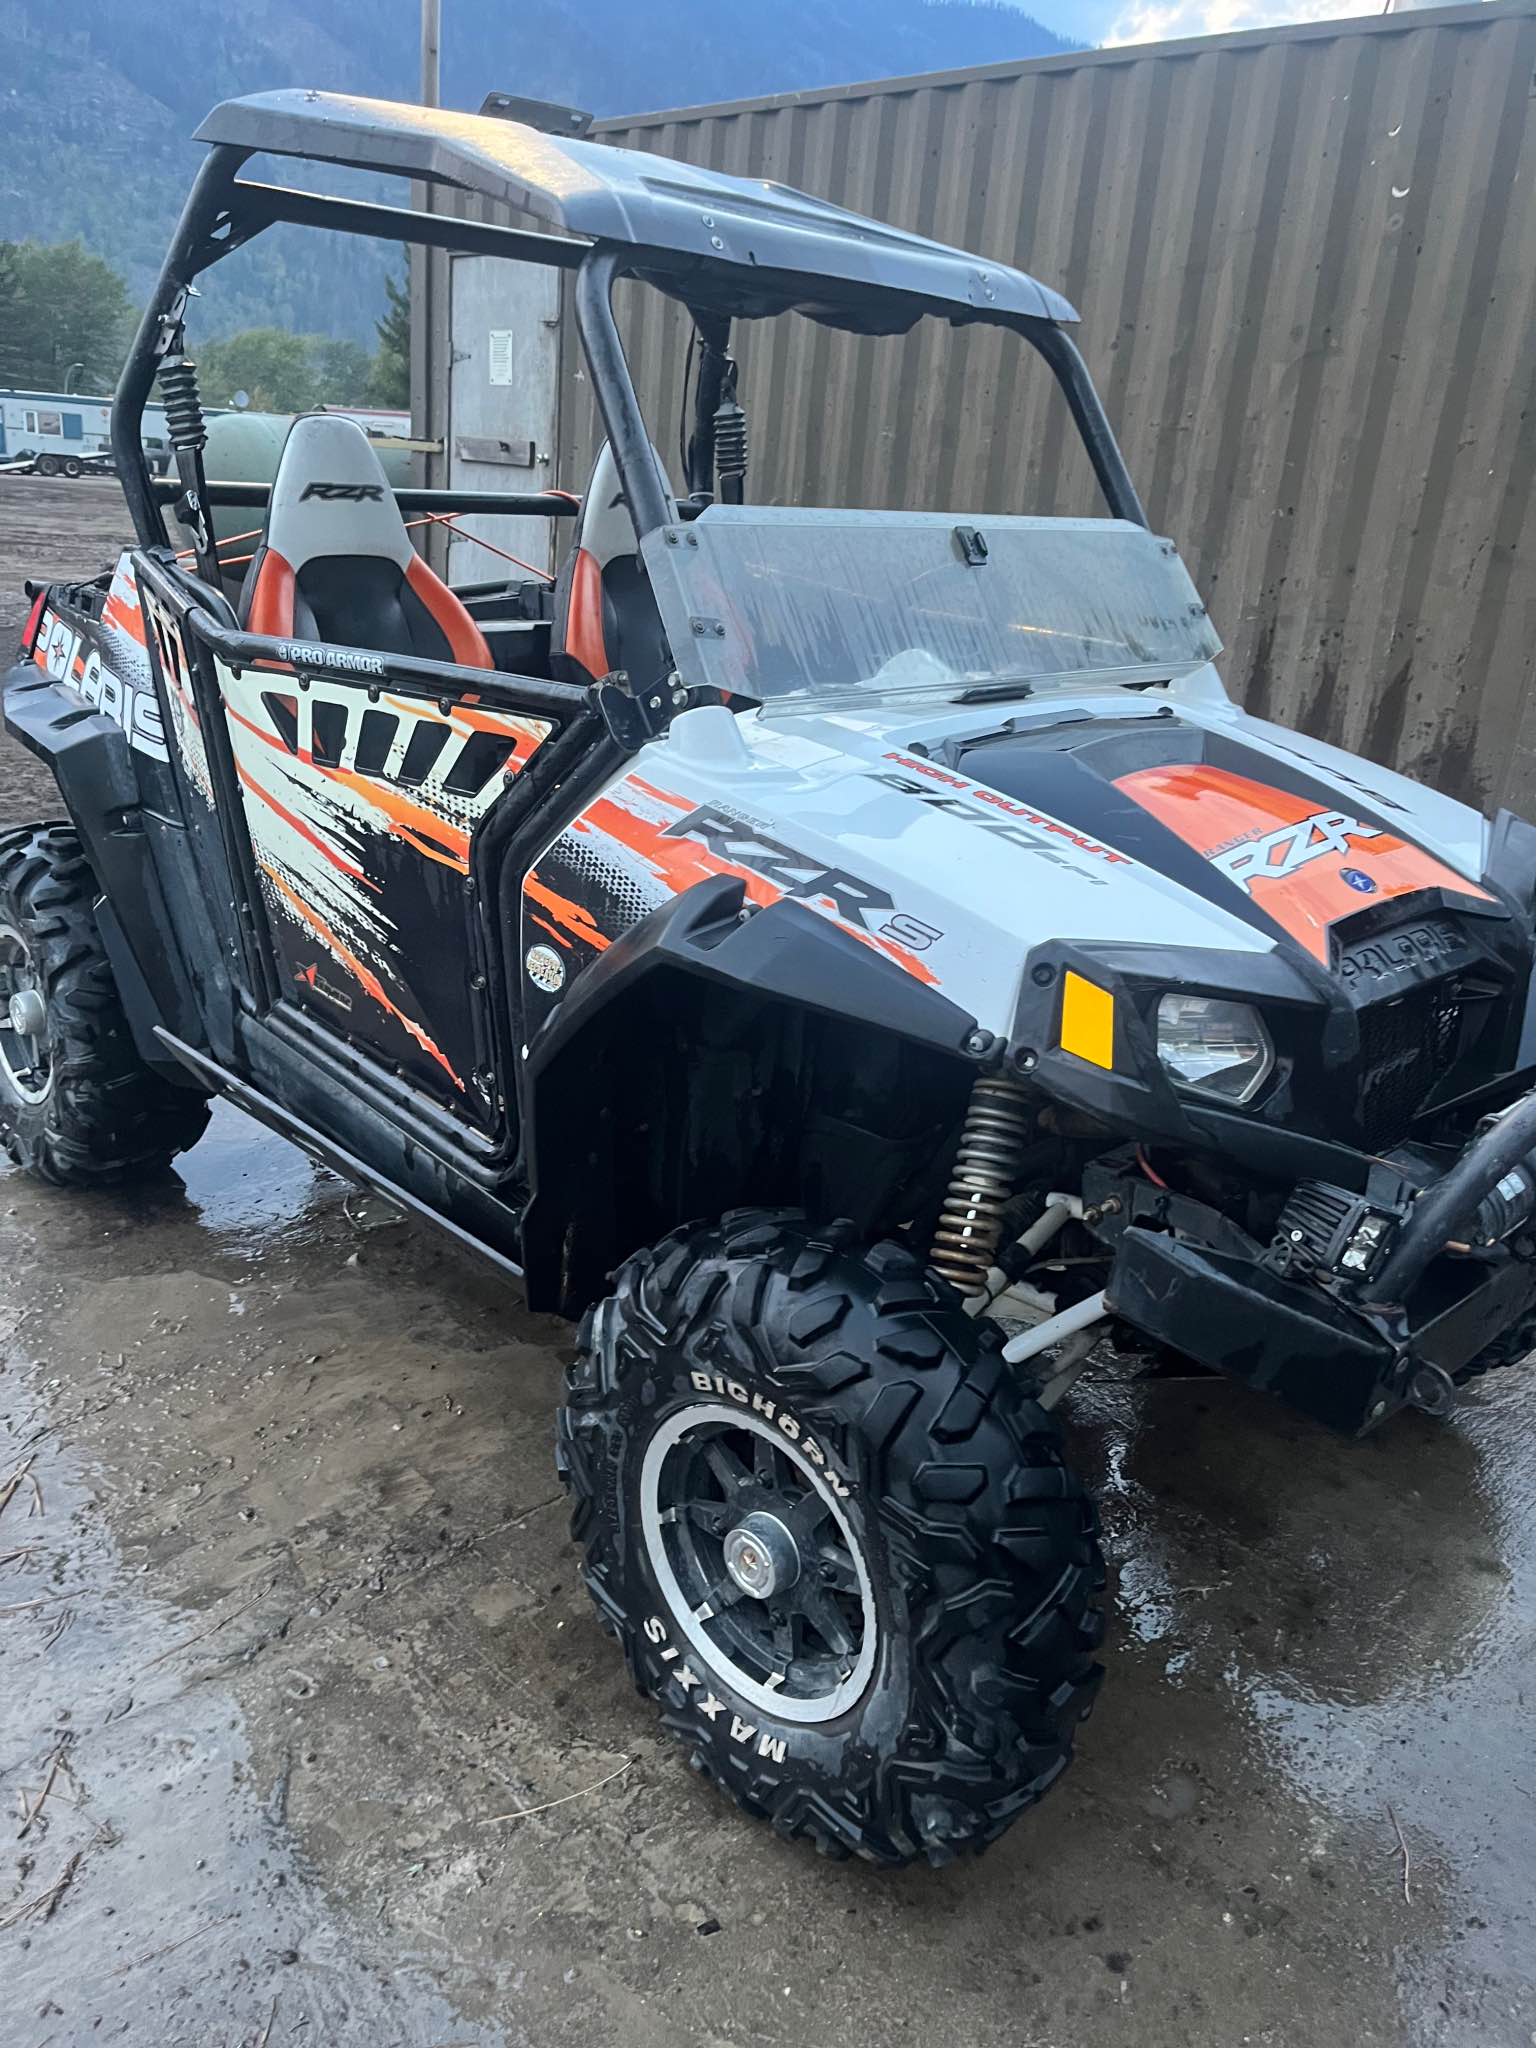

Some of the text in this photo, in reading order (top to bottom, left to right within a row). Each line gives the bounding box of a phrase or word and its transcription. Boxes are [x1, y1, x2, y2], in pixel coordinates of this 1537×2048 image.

[299, 482, 384, 502] RZR
[290, 646, 384, 675] PRO ARMOR
[882, 752, 1133, 865] HIGH OUTPUT
[1209, 811, 1383, 896] RZR
[691, 1371, 850, 1497] BIGHORN
[643, 1616, 787, 1764] MAXXIS
